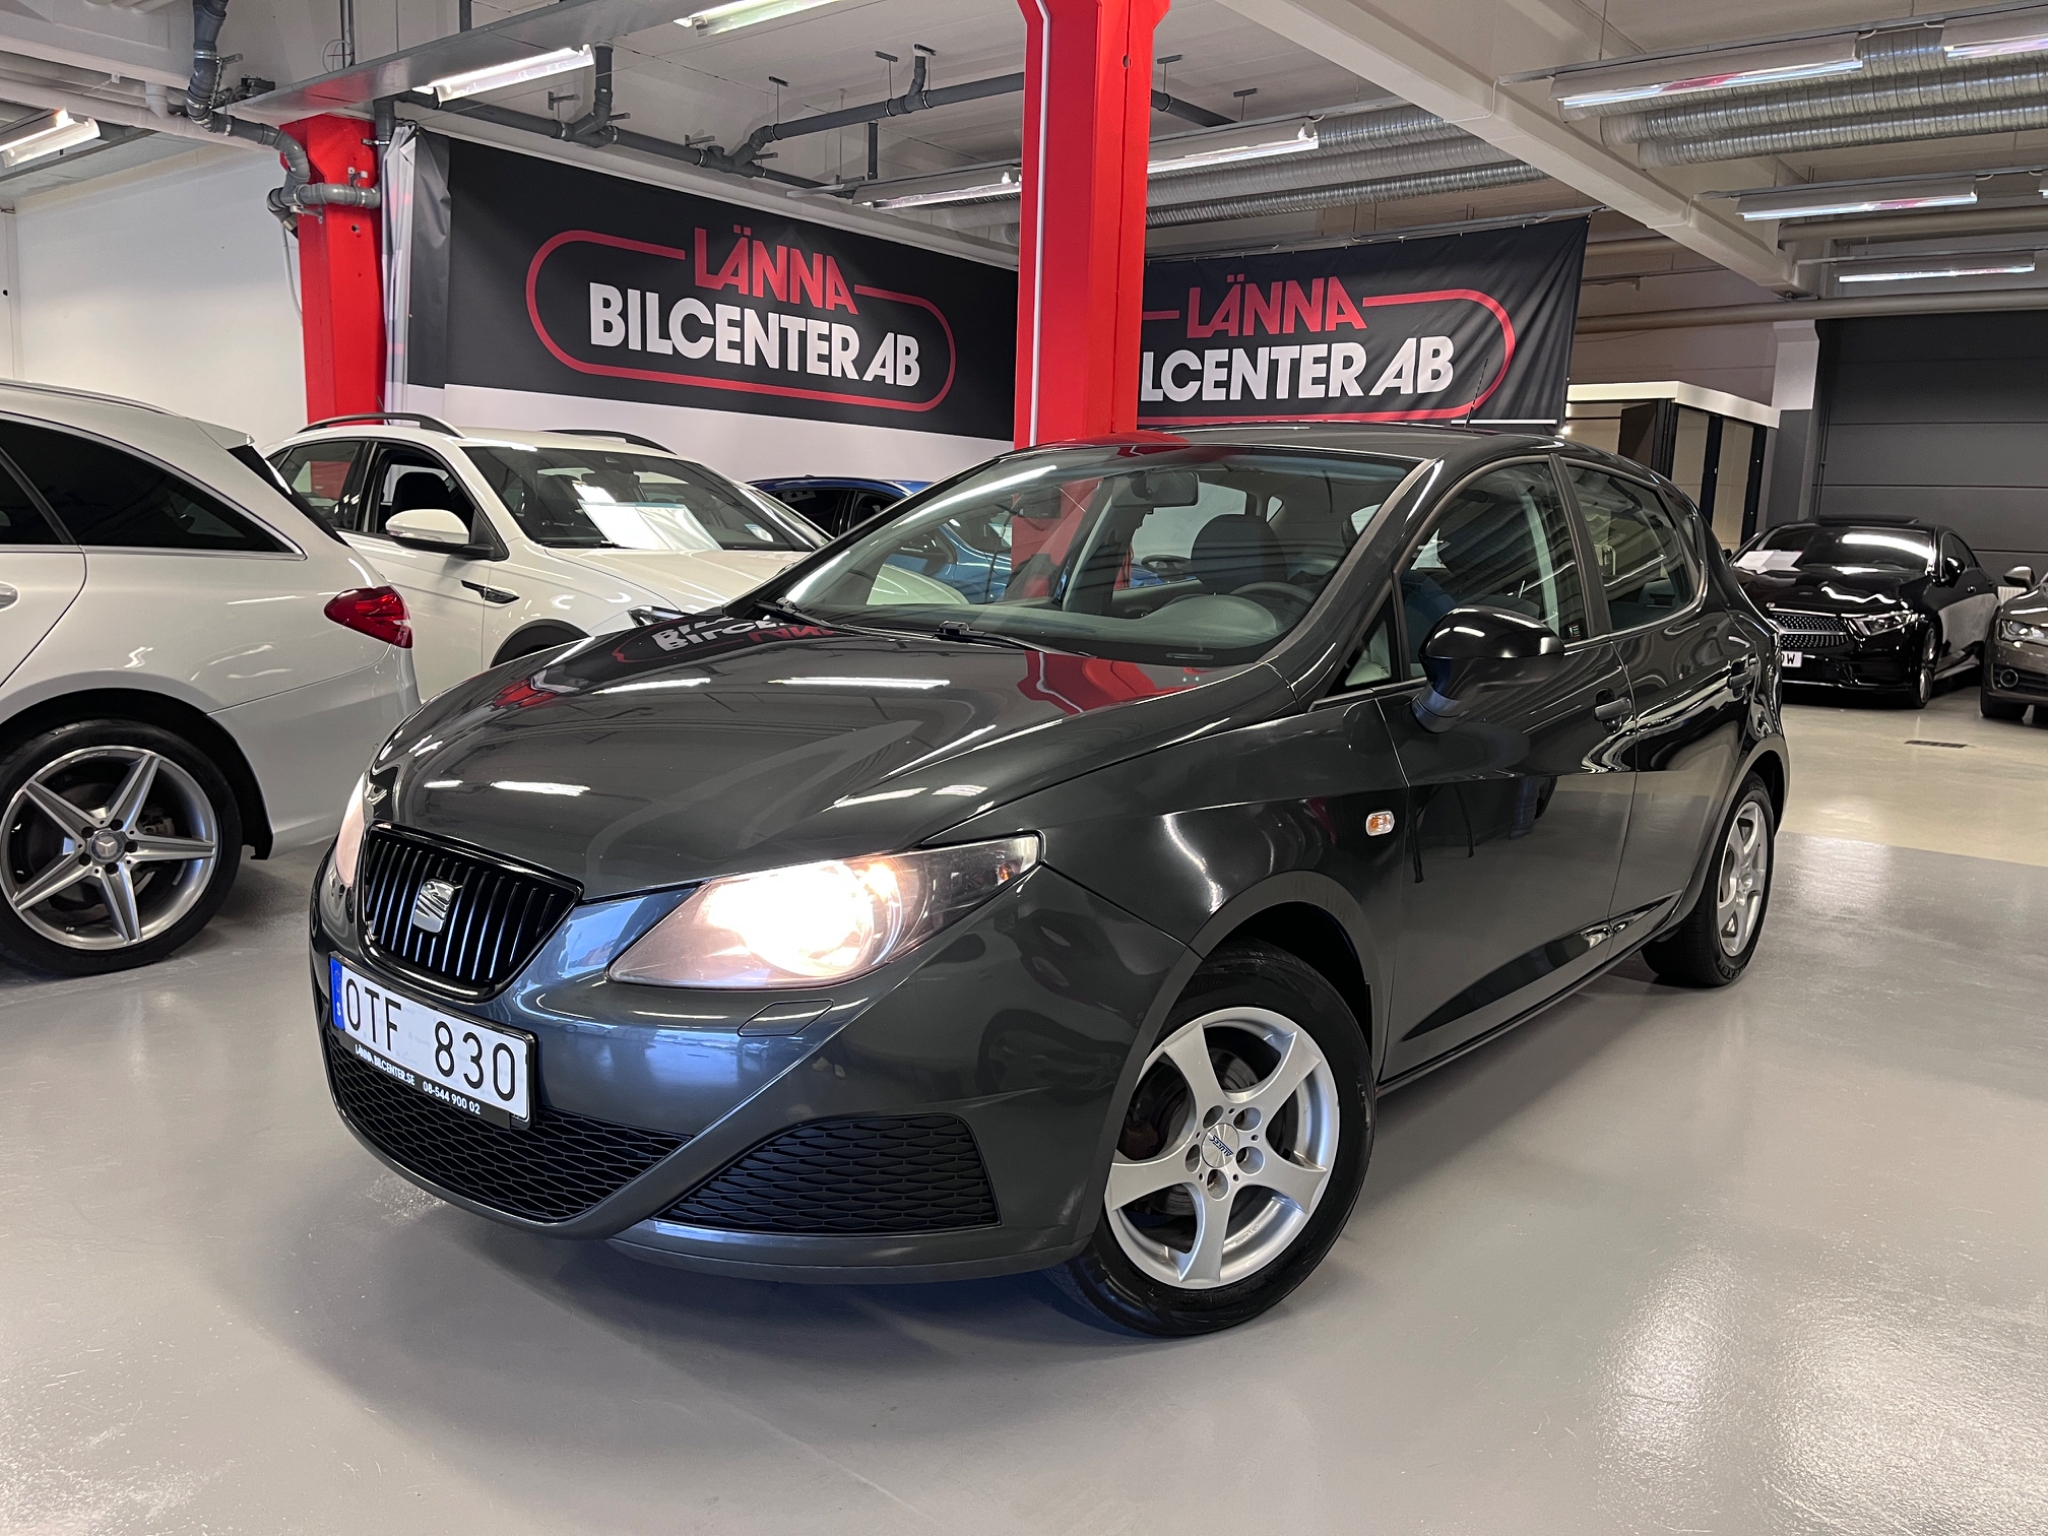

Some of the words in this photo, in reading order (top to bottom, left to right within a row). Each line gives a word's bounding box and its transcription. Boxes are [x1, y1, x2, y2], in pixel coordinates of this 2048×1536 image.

[694, 224, 859, 315] LÄNNA
[1186, 273, 1368, 339] LÄNNA
[589, 281, 860, 381] BILCENTER
[862, 332, 921, 387] AB
[1140, 341, 1364, 402] LCENTER
[1368, 335, 1455, 397] AB
[346, 978, 402, 1051] OTF
[434, 1020, 516, 1102] 830
[422, 1080, 450, 1102] 08-544
[451, 1094, 468, 1110] 900
[468, 1100, 481, 1115] 02
